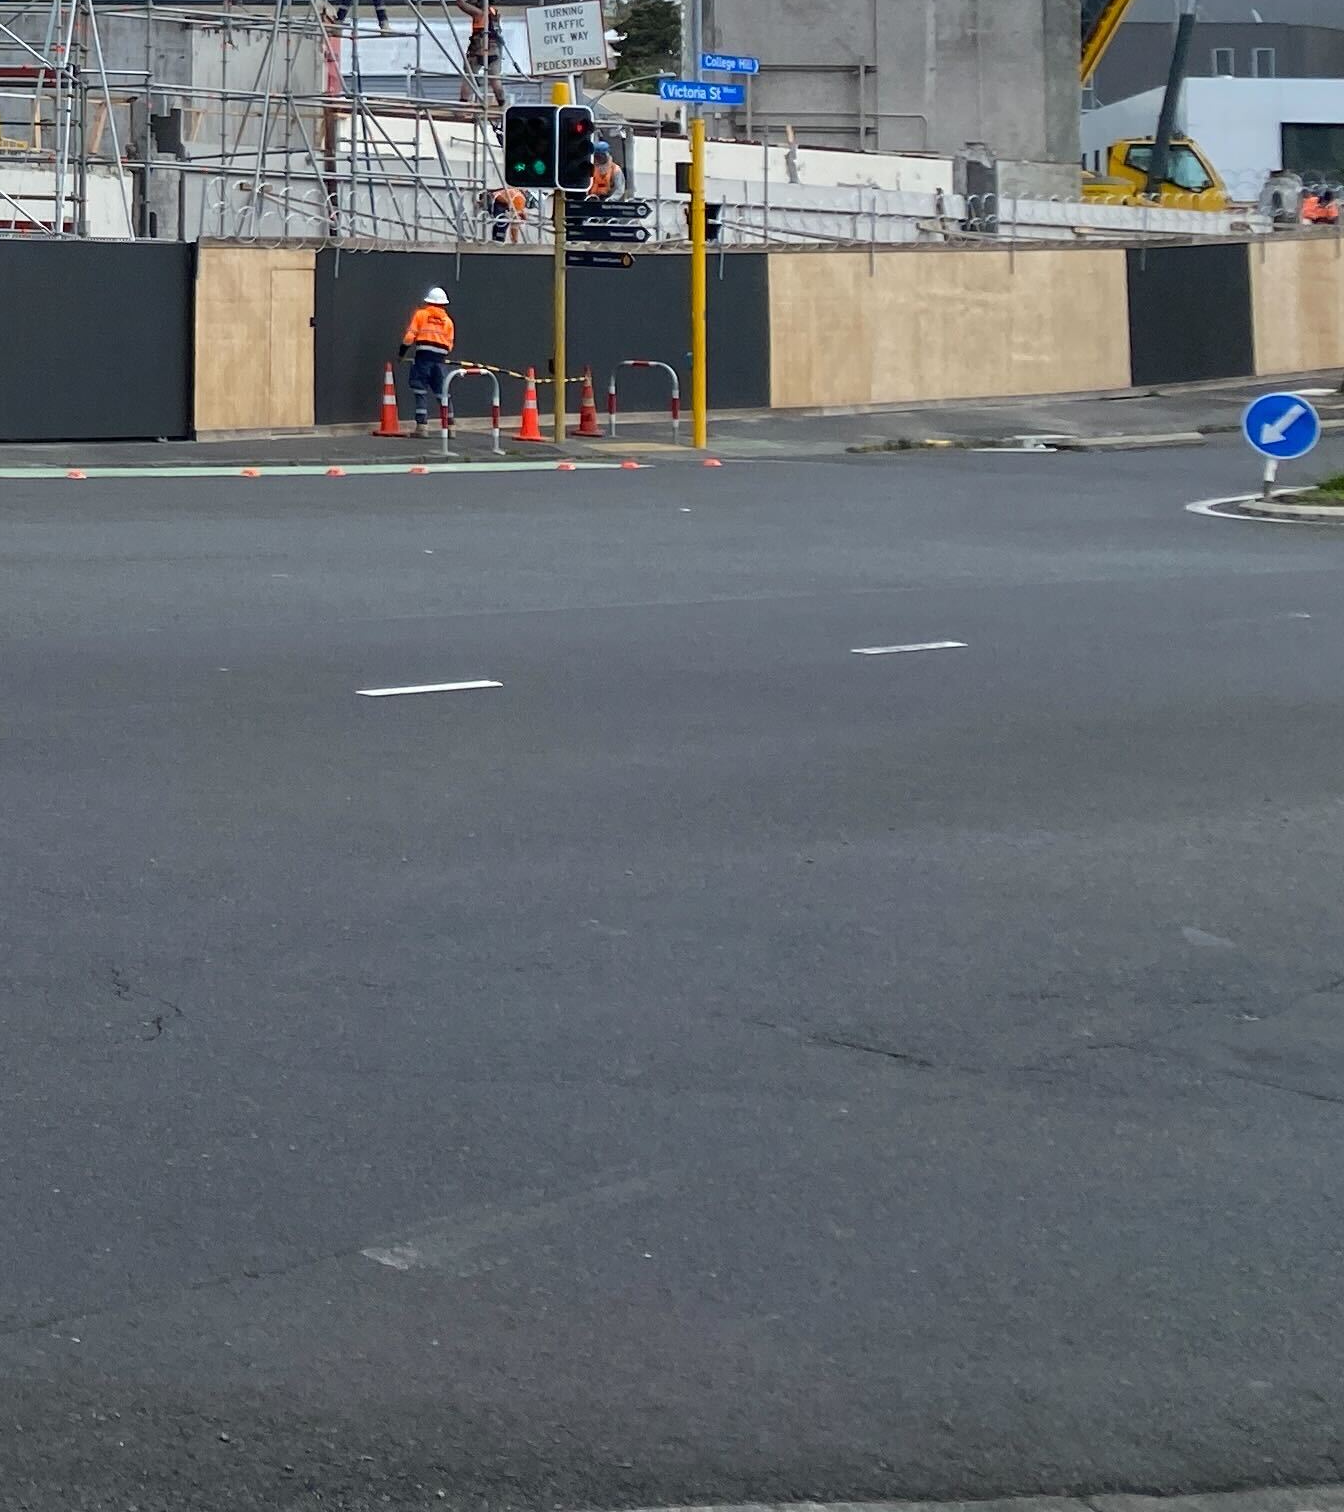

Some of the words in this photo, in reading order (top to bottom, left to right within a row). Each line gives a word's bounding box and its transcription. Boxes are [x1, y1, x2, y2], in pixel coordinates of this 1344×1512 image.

[544, 5, 584, 18] TURNING
[545, 18, 585, 31] TRAFFIC
[543, 34, 565, 45] GIVE
[570, 31, 589, 41] WAY
[561, 46, 574, 56] TO
[536, 56, 602, 71] PEDESTRIANS
[705, 55, 736, 70] College
[667, 84, 707, 100] Victoria
[709, 86, 722, 100] St
